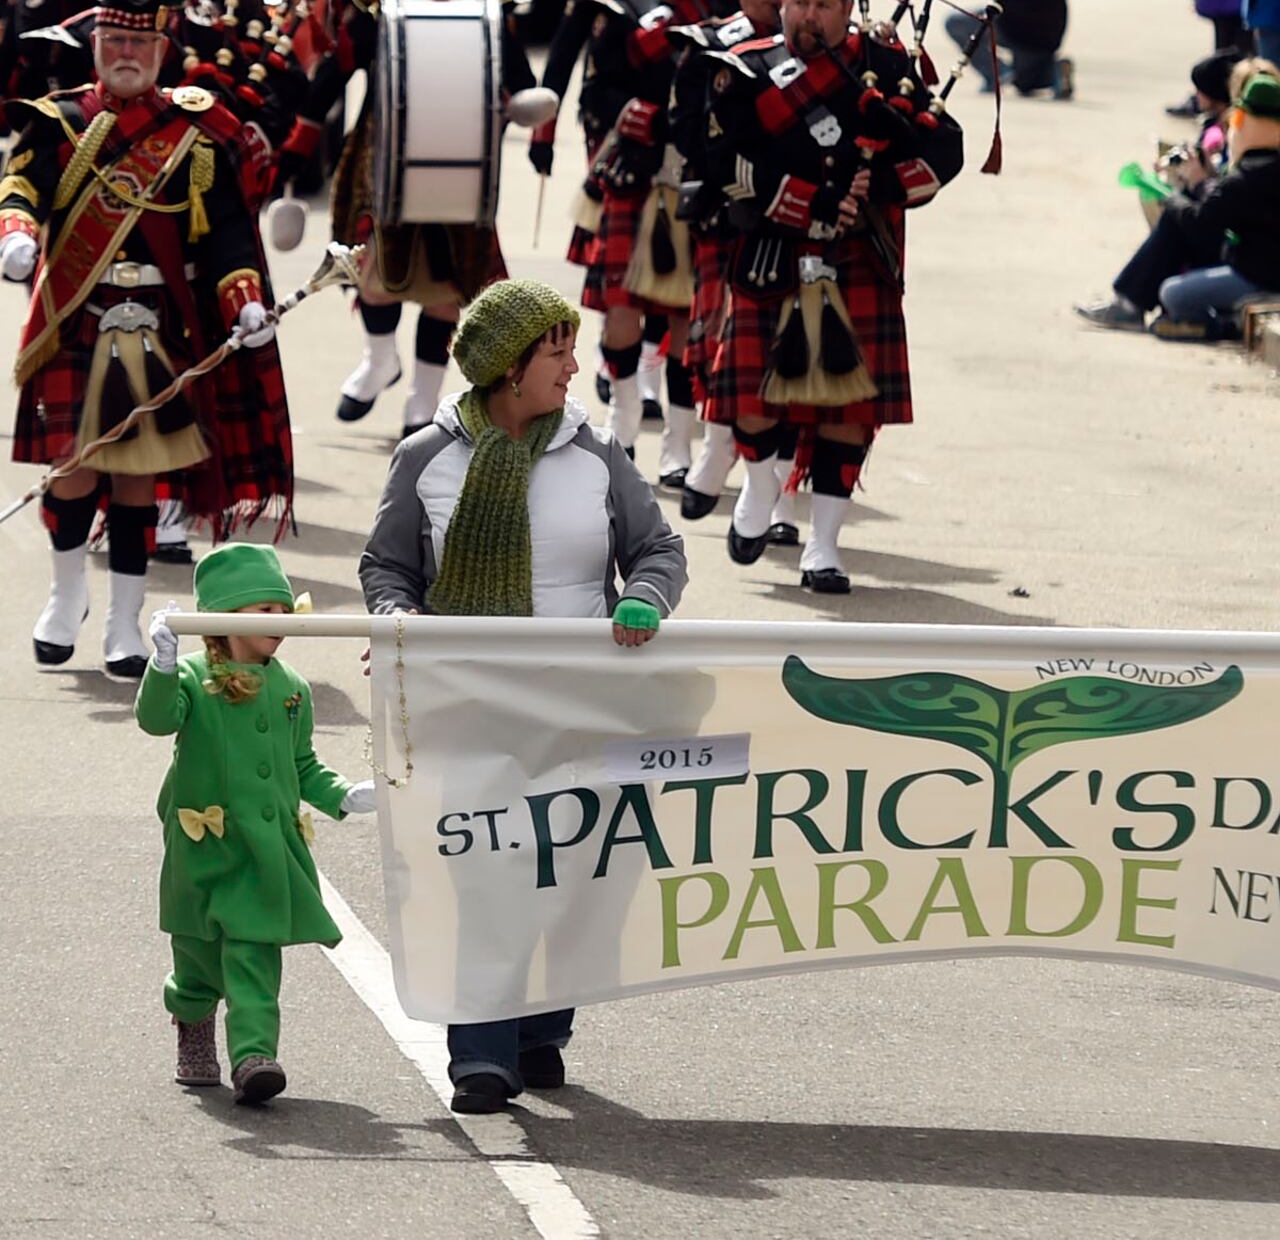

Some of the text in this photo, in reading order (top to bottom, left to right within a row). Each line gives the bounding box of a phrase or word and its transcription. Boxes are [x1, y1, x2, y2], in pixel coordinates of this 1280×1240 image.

[1034, 657, 1217, 688] NEW LONDON
[639, 744, 715, 771] 2015
[436, 806, 522, 858] ST.
[523, 767, 1196, 889] PATRICK'S
[657, 855, 1183, 970] PARADE
